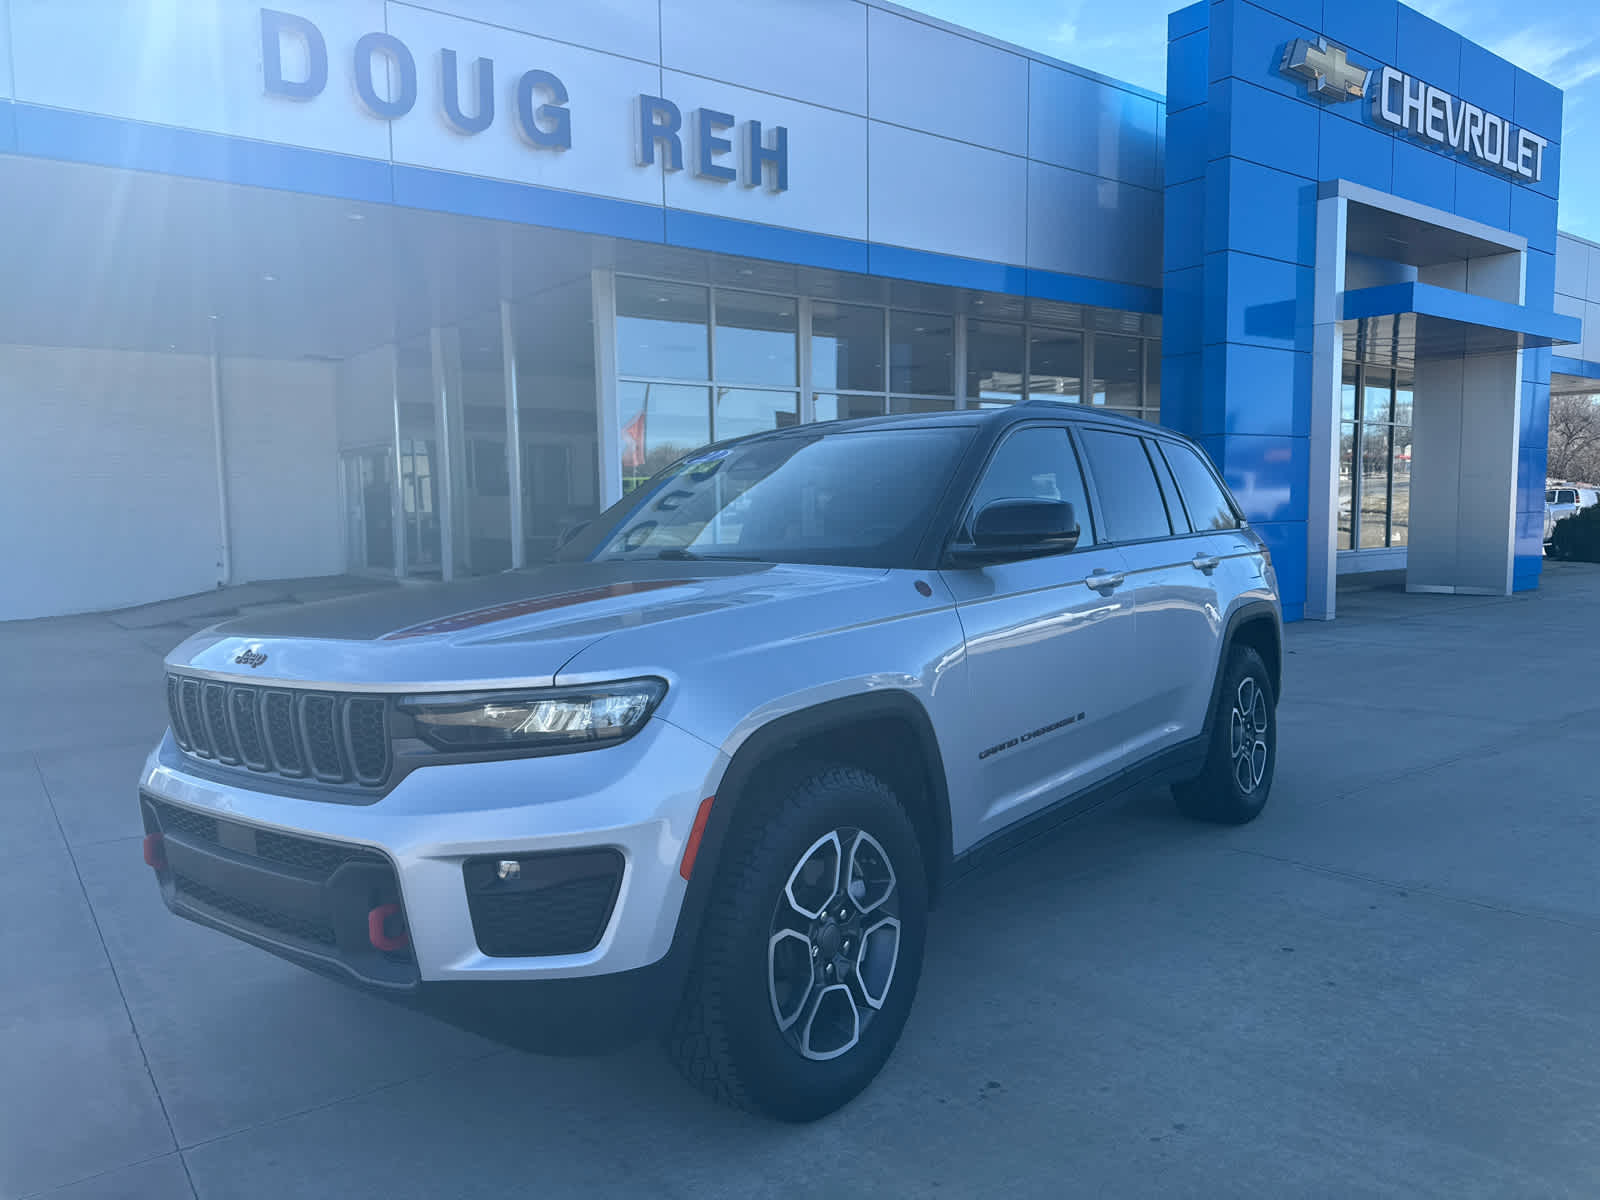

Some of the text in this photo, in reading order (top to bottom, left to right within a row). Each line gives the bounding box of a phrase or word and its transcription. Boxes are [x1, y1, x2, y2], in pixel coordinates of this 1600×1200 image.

[260, 8, 788, 194] DOUG REH
[1379, 66, 1547, 181] CHEVROLET
[235, 649, 268, 668] Jeep
